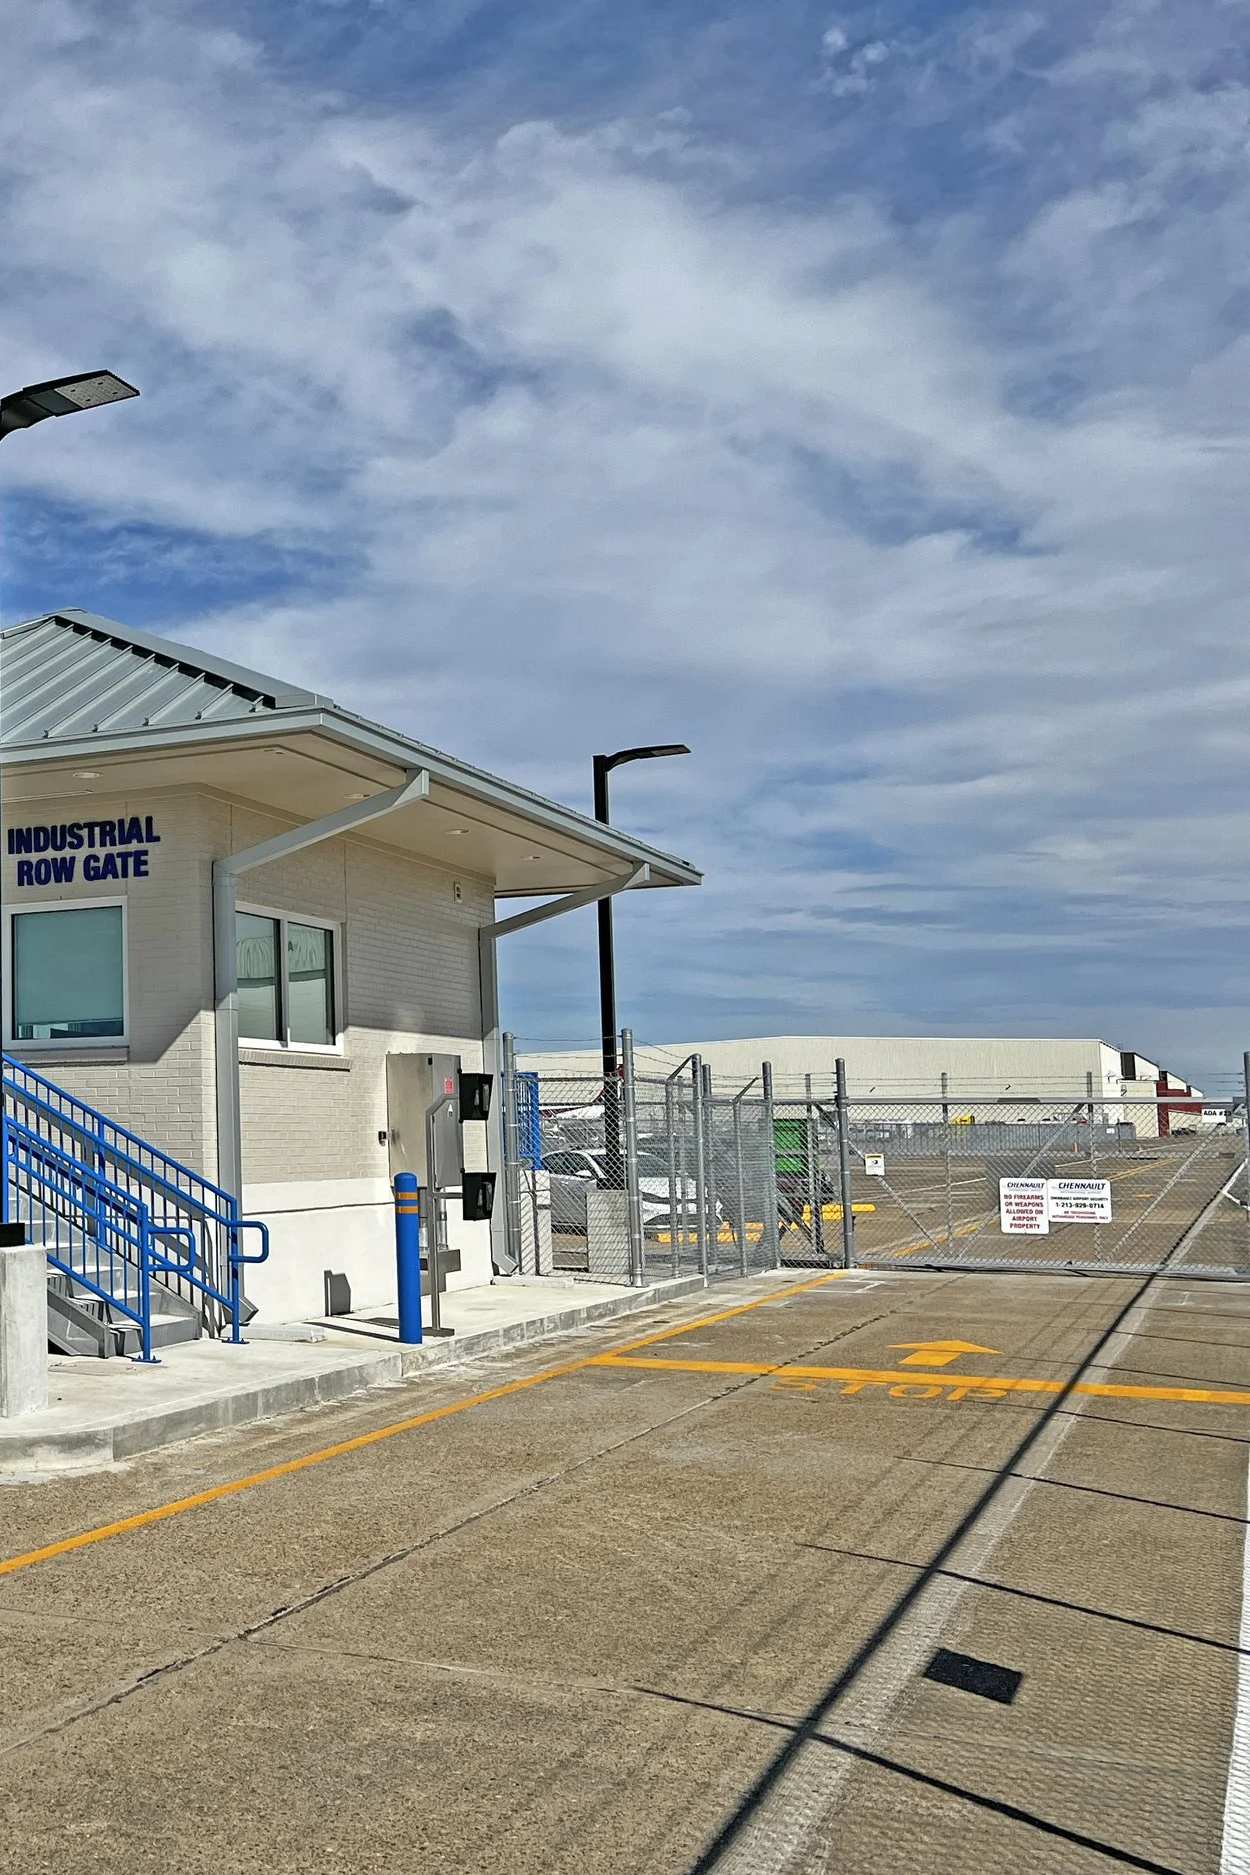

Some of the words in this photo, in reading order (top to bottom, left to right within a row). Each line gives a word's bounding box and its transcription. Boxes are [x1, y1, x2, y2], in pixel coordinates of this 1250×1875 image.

[7, 815, 161, 855] INDUSTRIAL
[17, 856, 76, 887] ROW
[83, 850, 149, 882] GATE
[1058, 1182, 1106, 1190] CHENNAULT
[769, 1376, 1007, 1400] STOP
